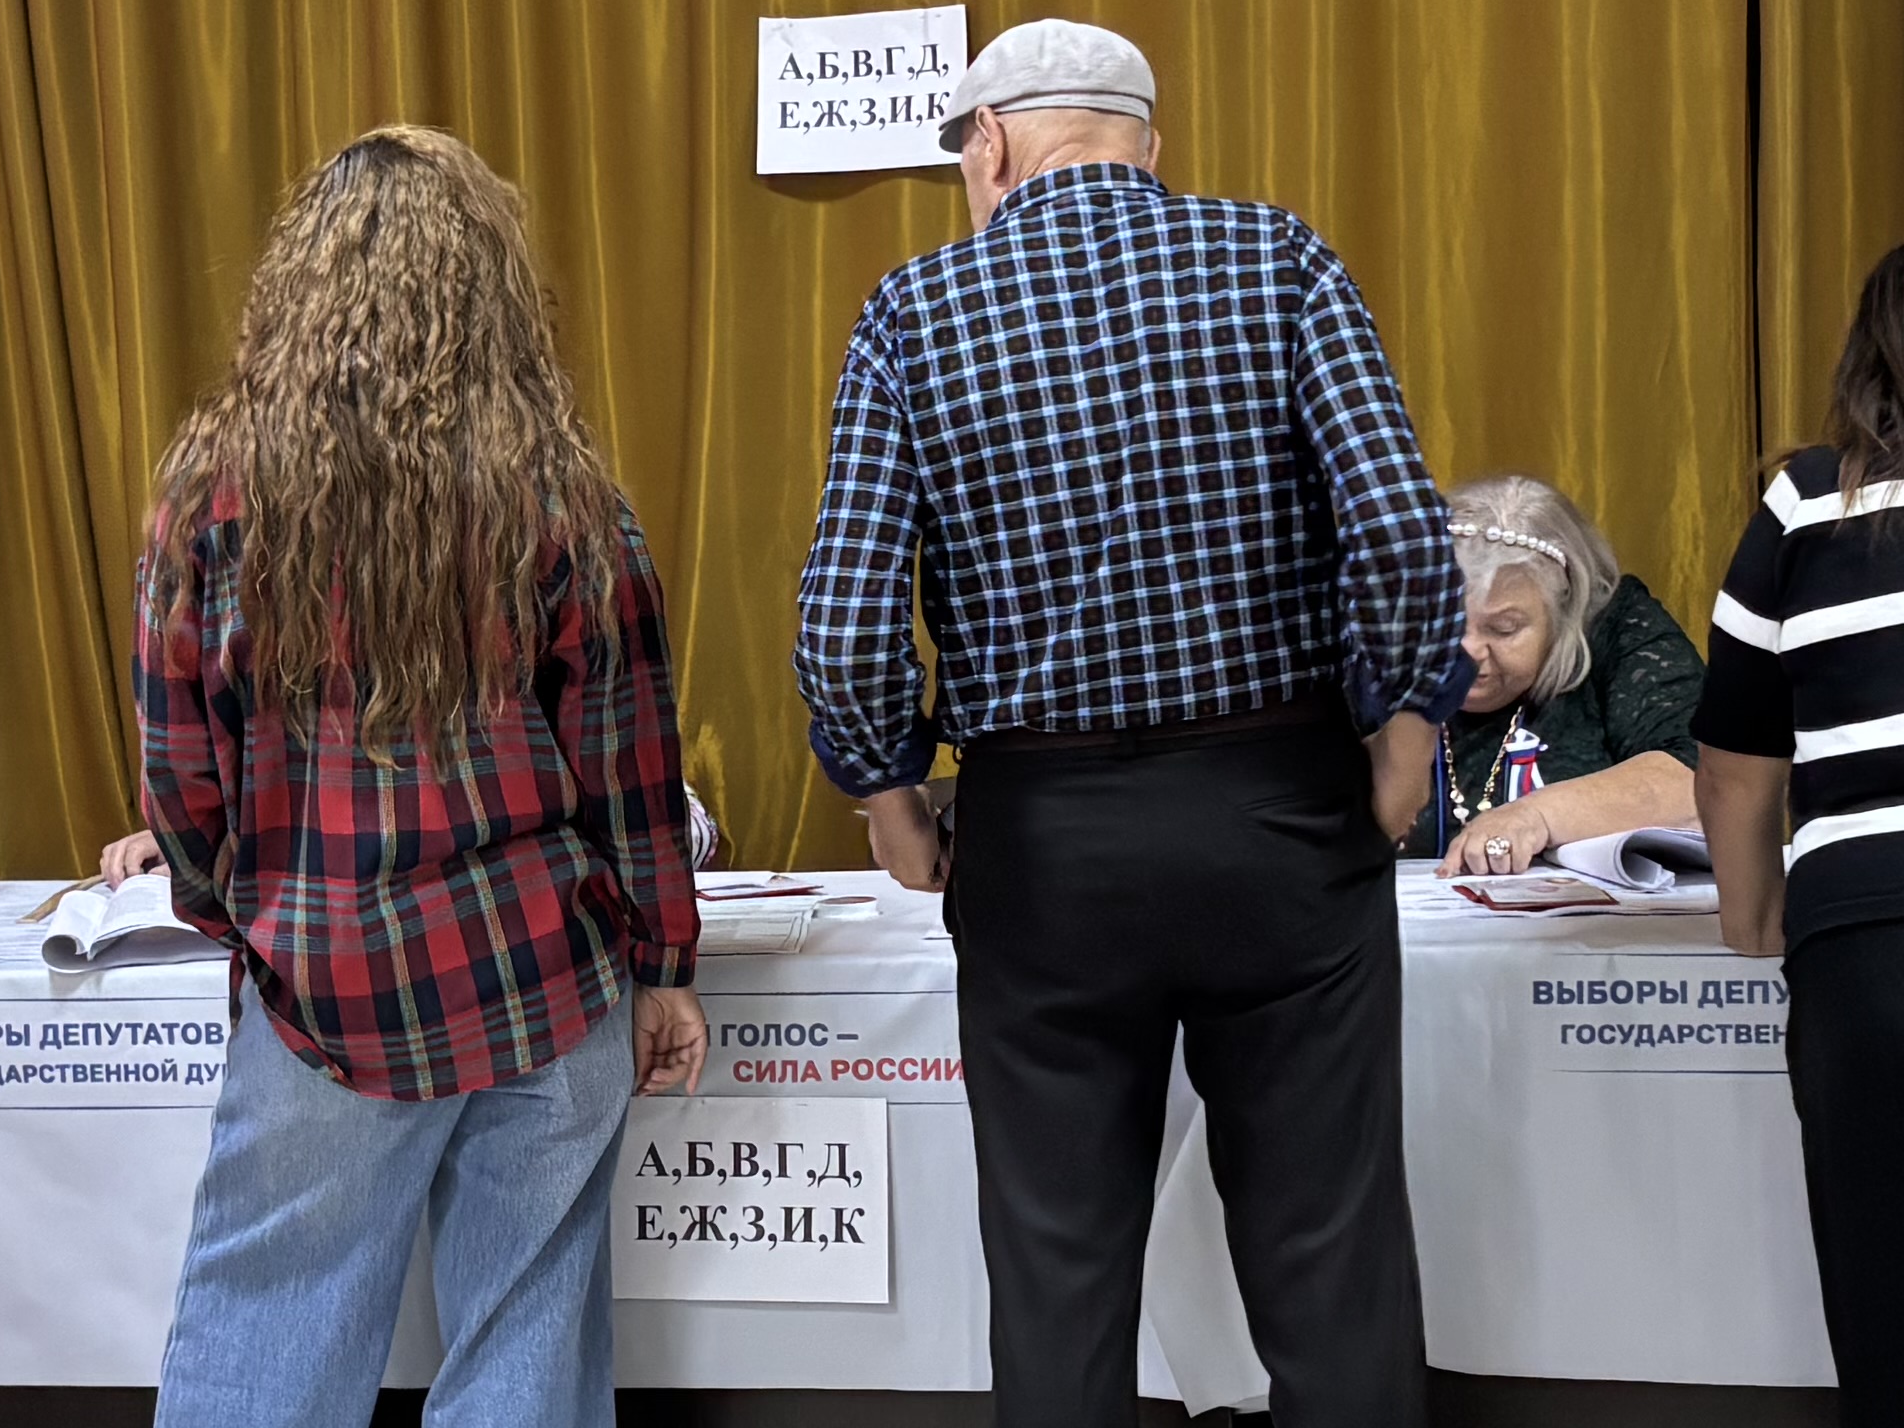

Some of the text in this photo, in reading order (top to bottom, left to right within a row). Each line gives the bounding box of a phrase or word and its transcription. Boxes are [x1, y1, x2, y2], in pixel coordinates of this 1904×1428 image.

[778, 43, 948, 85] А,Б,В,Г,Д,
[778, 91, 950, 134] Е,Ж,З,И,К
[1532, 980, 1790, 1008] ВЫБОРЫ ДЕПУ
[40, 1021, 224, 1050] ДЕПУТАТОВ
[721, 1022, 827, 1047] ГОЛОС
[1560, 1024, 1787, 1047] ГОСУДАРСТВЕН
[185, 1063, 227, 1086] ДУ
[733, 1059, 821, 1083] СИЛА
[636, 1140, 863, 1188] А,Б,В,Г,Д,
[635, 1204, 865, 1250] Е,Ж,З,И,К
